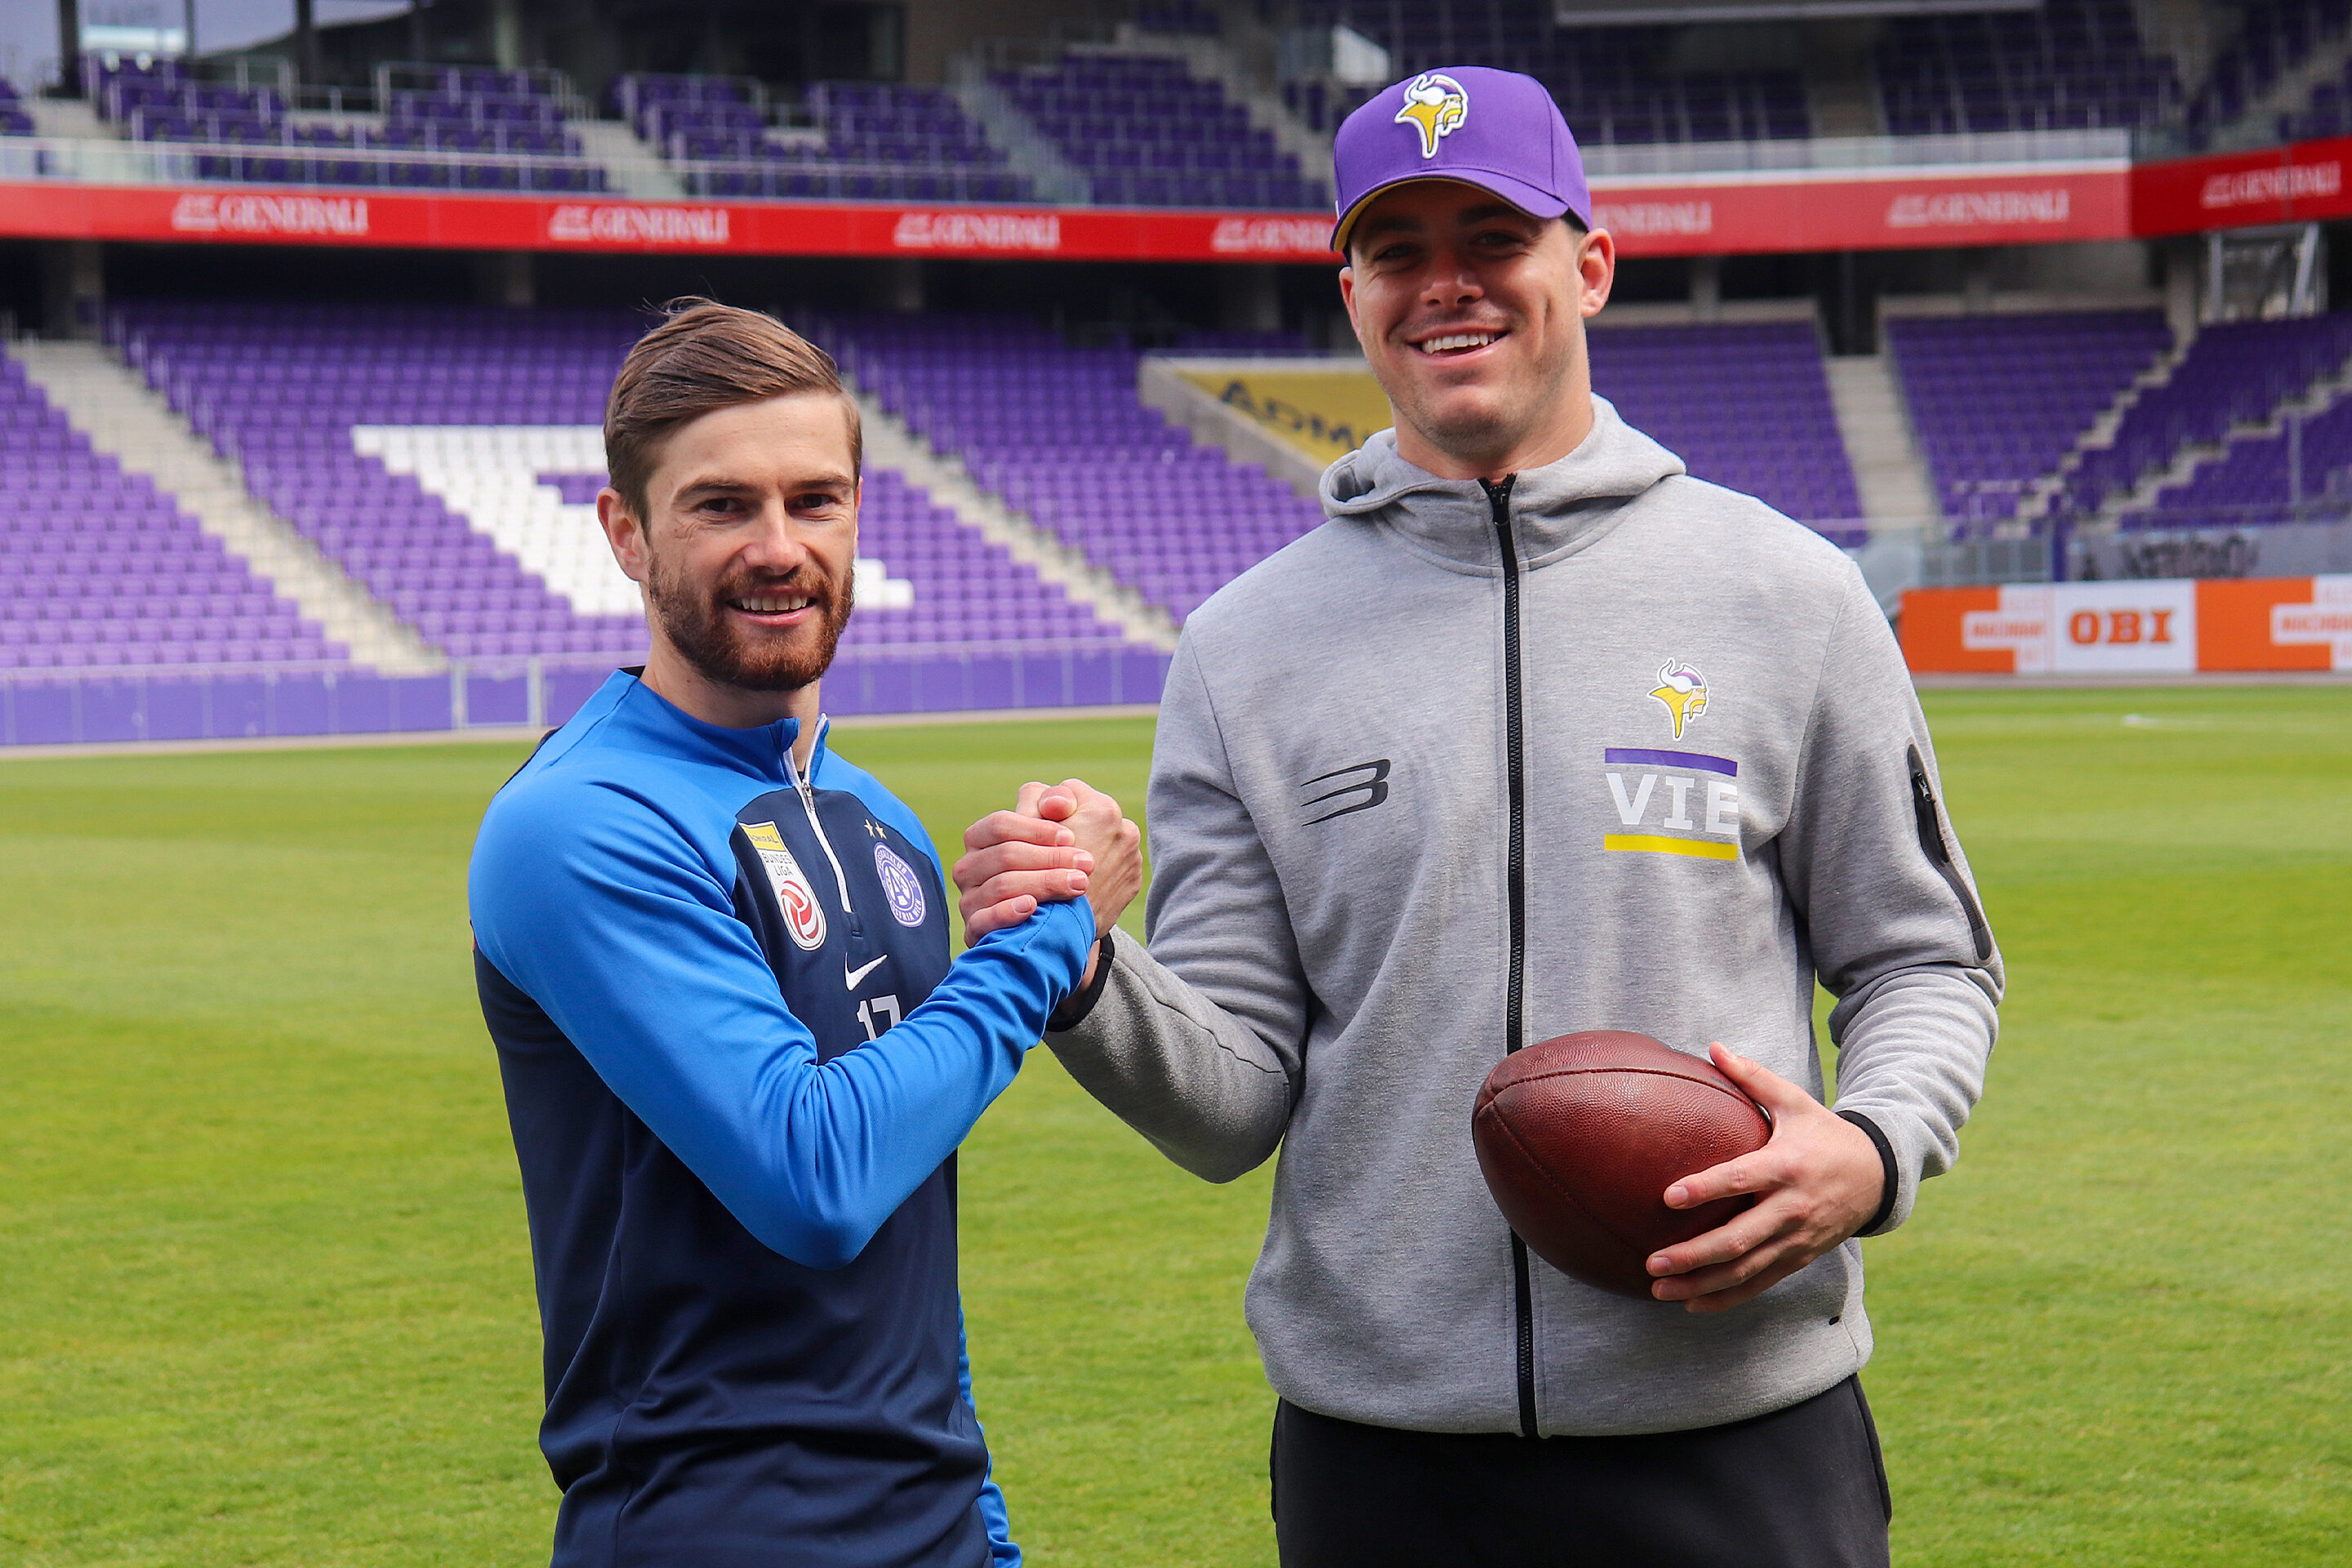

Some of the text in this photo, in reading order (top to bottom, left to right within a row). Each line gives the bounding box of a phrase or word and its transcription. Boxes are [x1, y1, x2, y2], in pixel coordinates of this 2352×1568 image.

[218, 194, 368, 234] GENERALI
[592, 207, 729, 244] GENERALI
[1592, 201, 1713, 235] ENERALI
[1928, 189, 2070, 226] GENERALI
[933, 214, 1060, 250] GENERALI
[2069, 609, 2175, 645] OBI
[1606, 773, 1739, 835] VIE
[749, 834, 779, 844] ADMIRAL
[761, 853, 792, 864] BUNDES
[773, 866, 794, 876] LIGA
[857, 994, 902, 1041] 17
